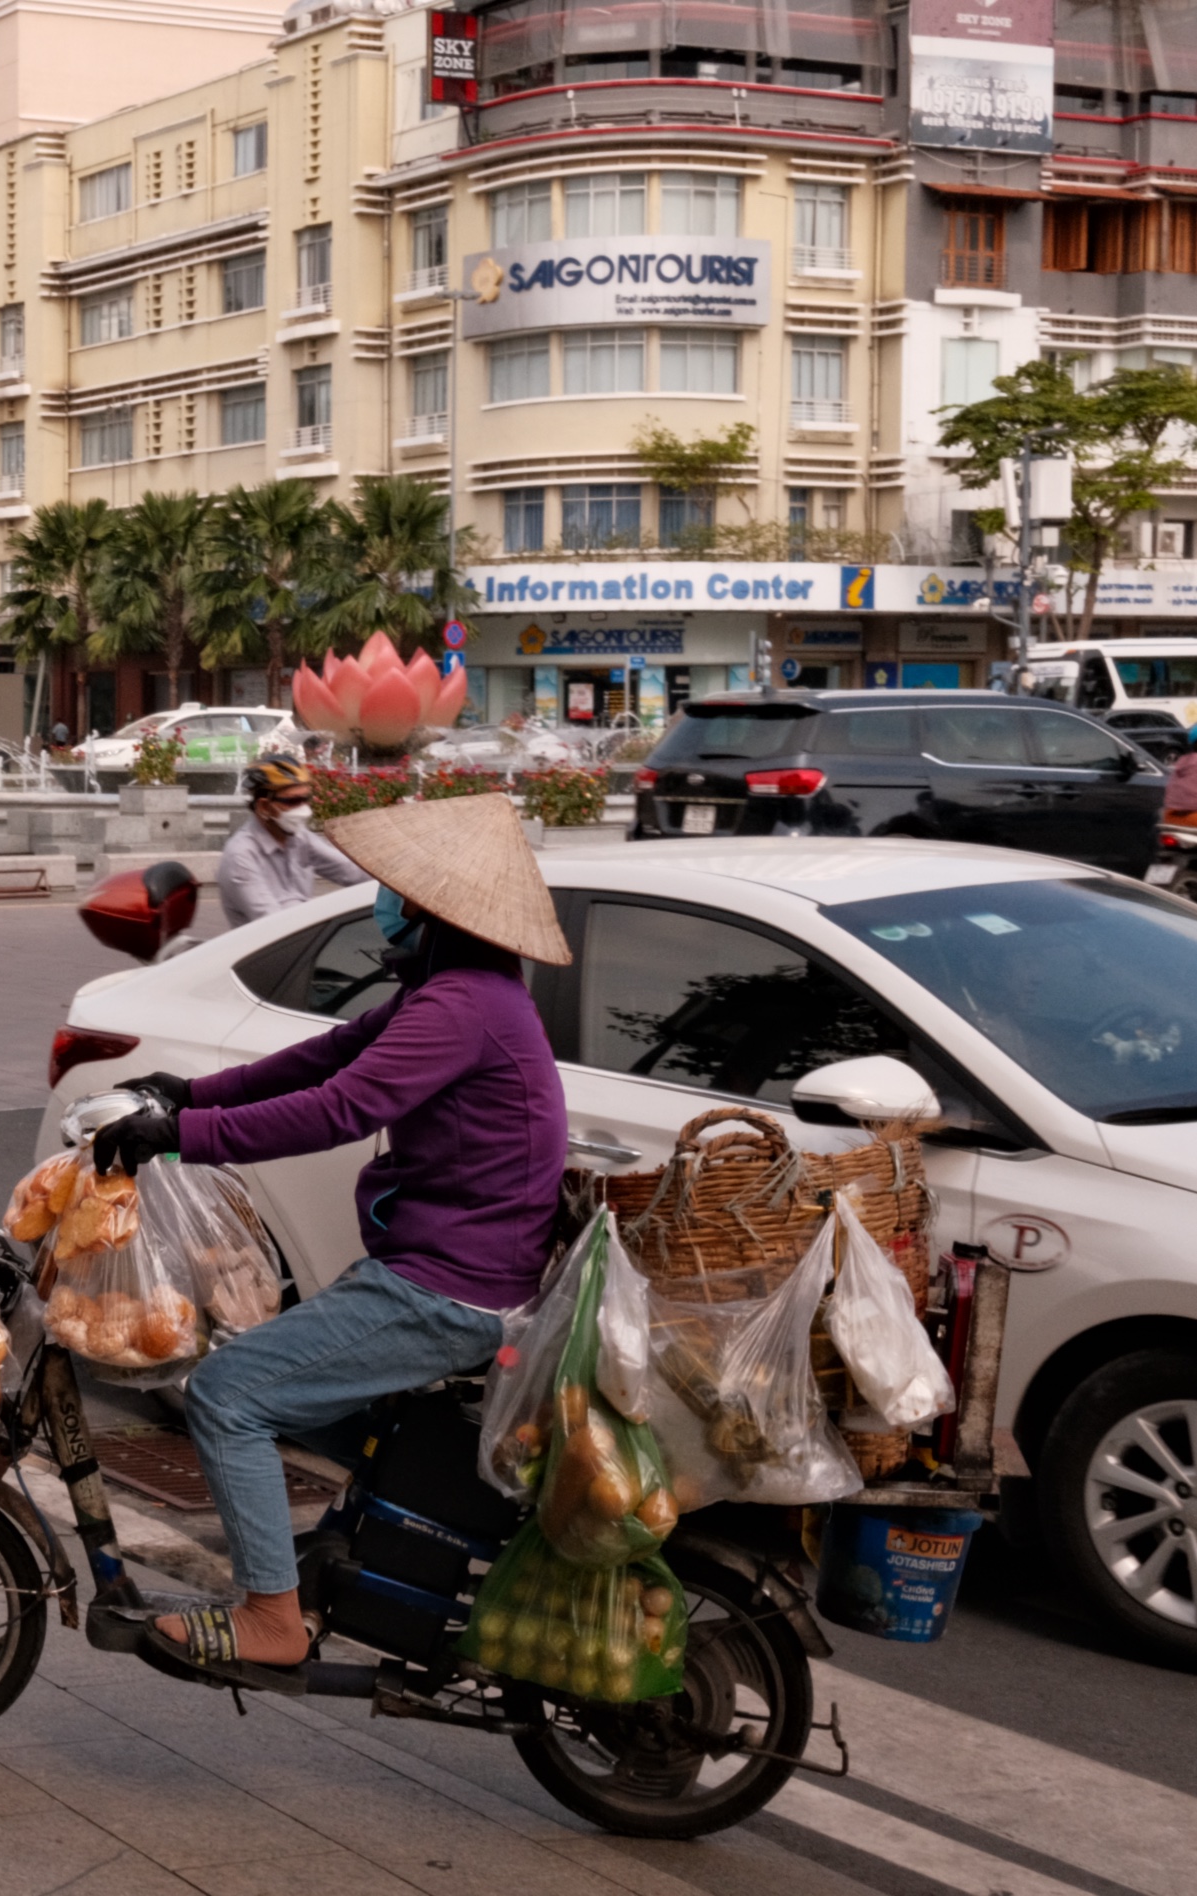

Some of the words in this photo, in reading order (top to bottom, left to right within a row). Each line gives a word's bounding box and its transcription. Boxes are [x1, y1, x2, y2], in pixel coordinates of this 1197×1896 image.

[433, 37, 475, 56] SKY
[433, 56, 475, 70] ZONE
[509, 254, 759, 293] SAIGONTOURIST
[486, 573, 694, 602] Information
[706, 573, 814, 600] Center
[551, 628, 685, 647] SAIGONTOURIST
[1011, 1224, 1042, 1259] P
[909, 1537, 962, 1555] JOTUN
[886, 1554, 957, 1572] JOTASHIELD
